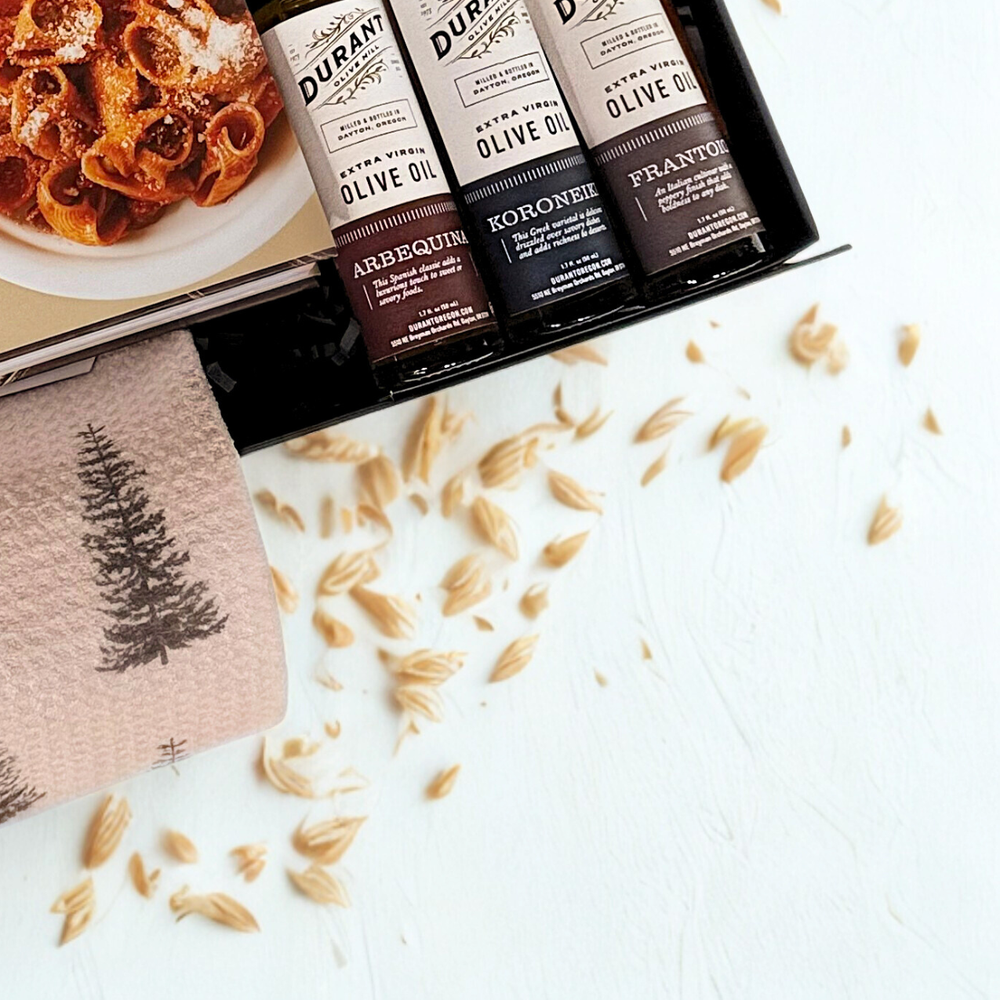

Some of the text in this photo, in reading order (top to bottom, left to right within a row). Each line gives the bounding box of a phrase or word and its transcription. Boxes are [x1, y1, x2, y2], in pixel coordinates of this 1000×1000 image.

[468, 15, 493, 41] OLIVE
[637, 30, 664, 41] OREGON
[298, 15, 383, 106] DURANT
[334, 45, 379, 87] OLIVE MILL
[511, 70, 540, 81] OREGON
[604, 60, 684, 94] EXTRA VIRGIN
[606, 71, 697, 118] OLIVE OIL
[376, 117, 406, 128] OREGON
[476, 100, 558, 133] EXTRA VIRGIN
[477, 112, 570, 158] OLIVE OIL
[340, 148, 425, 179] EXTRA VIRGIN
[341, 160, 437, 205] OLIVE OIL
[654, 188, 666, 197] An
[667, 179, 693, 192] Italian
[658, 191, 685, 207] peppery
[685, 181, 706, 196] finish
[692, 193, 700, 201] to
[512, 232, 528, 242] This
[530, 222, 550, 236] Greek
[552, 213, 578, 228] varietal
[516, 234, 545, 251] drizzled
[546, 230, 562, 240] over
[564, 223, 585, 234] savory
[354, 230, 469, 278] ARBEQUINA
[519, 249, 532, 259] and
[534, 243, 551, 254] adds
[552, 234, 580, 248] richness
[581, 228, 588, 238] to
[372, 278, 388, 289] This
[389, 267, 417, 285] Spanish
[419, 260, 440, 273] classic
[442, 256, 456, 266] adds
[409, 274, 429, 287] touch
[430, 271, 438, 279] to
[439, 267, 456, 276] sweet
[379, 294, 400, 306] savory
[408, 306, 474, 332] DURANTOREGON.COM
